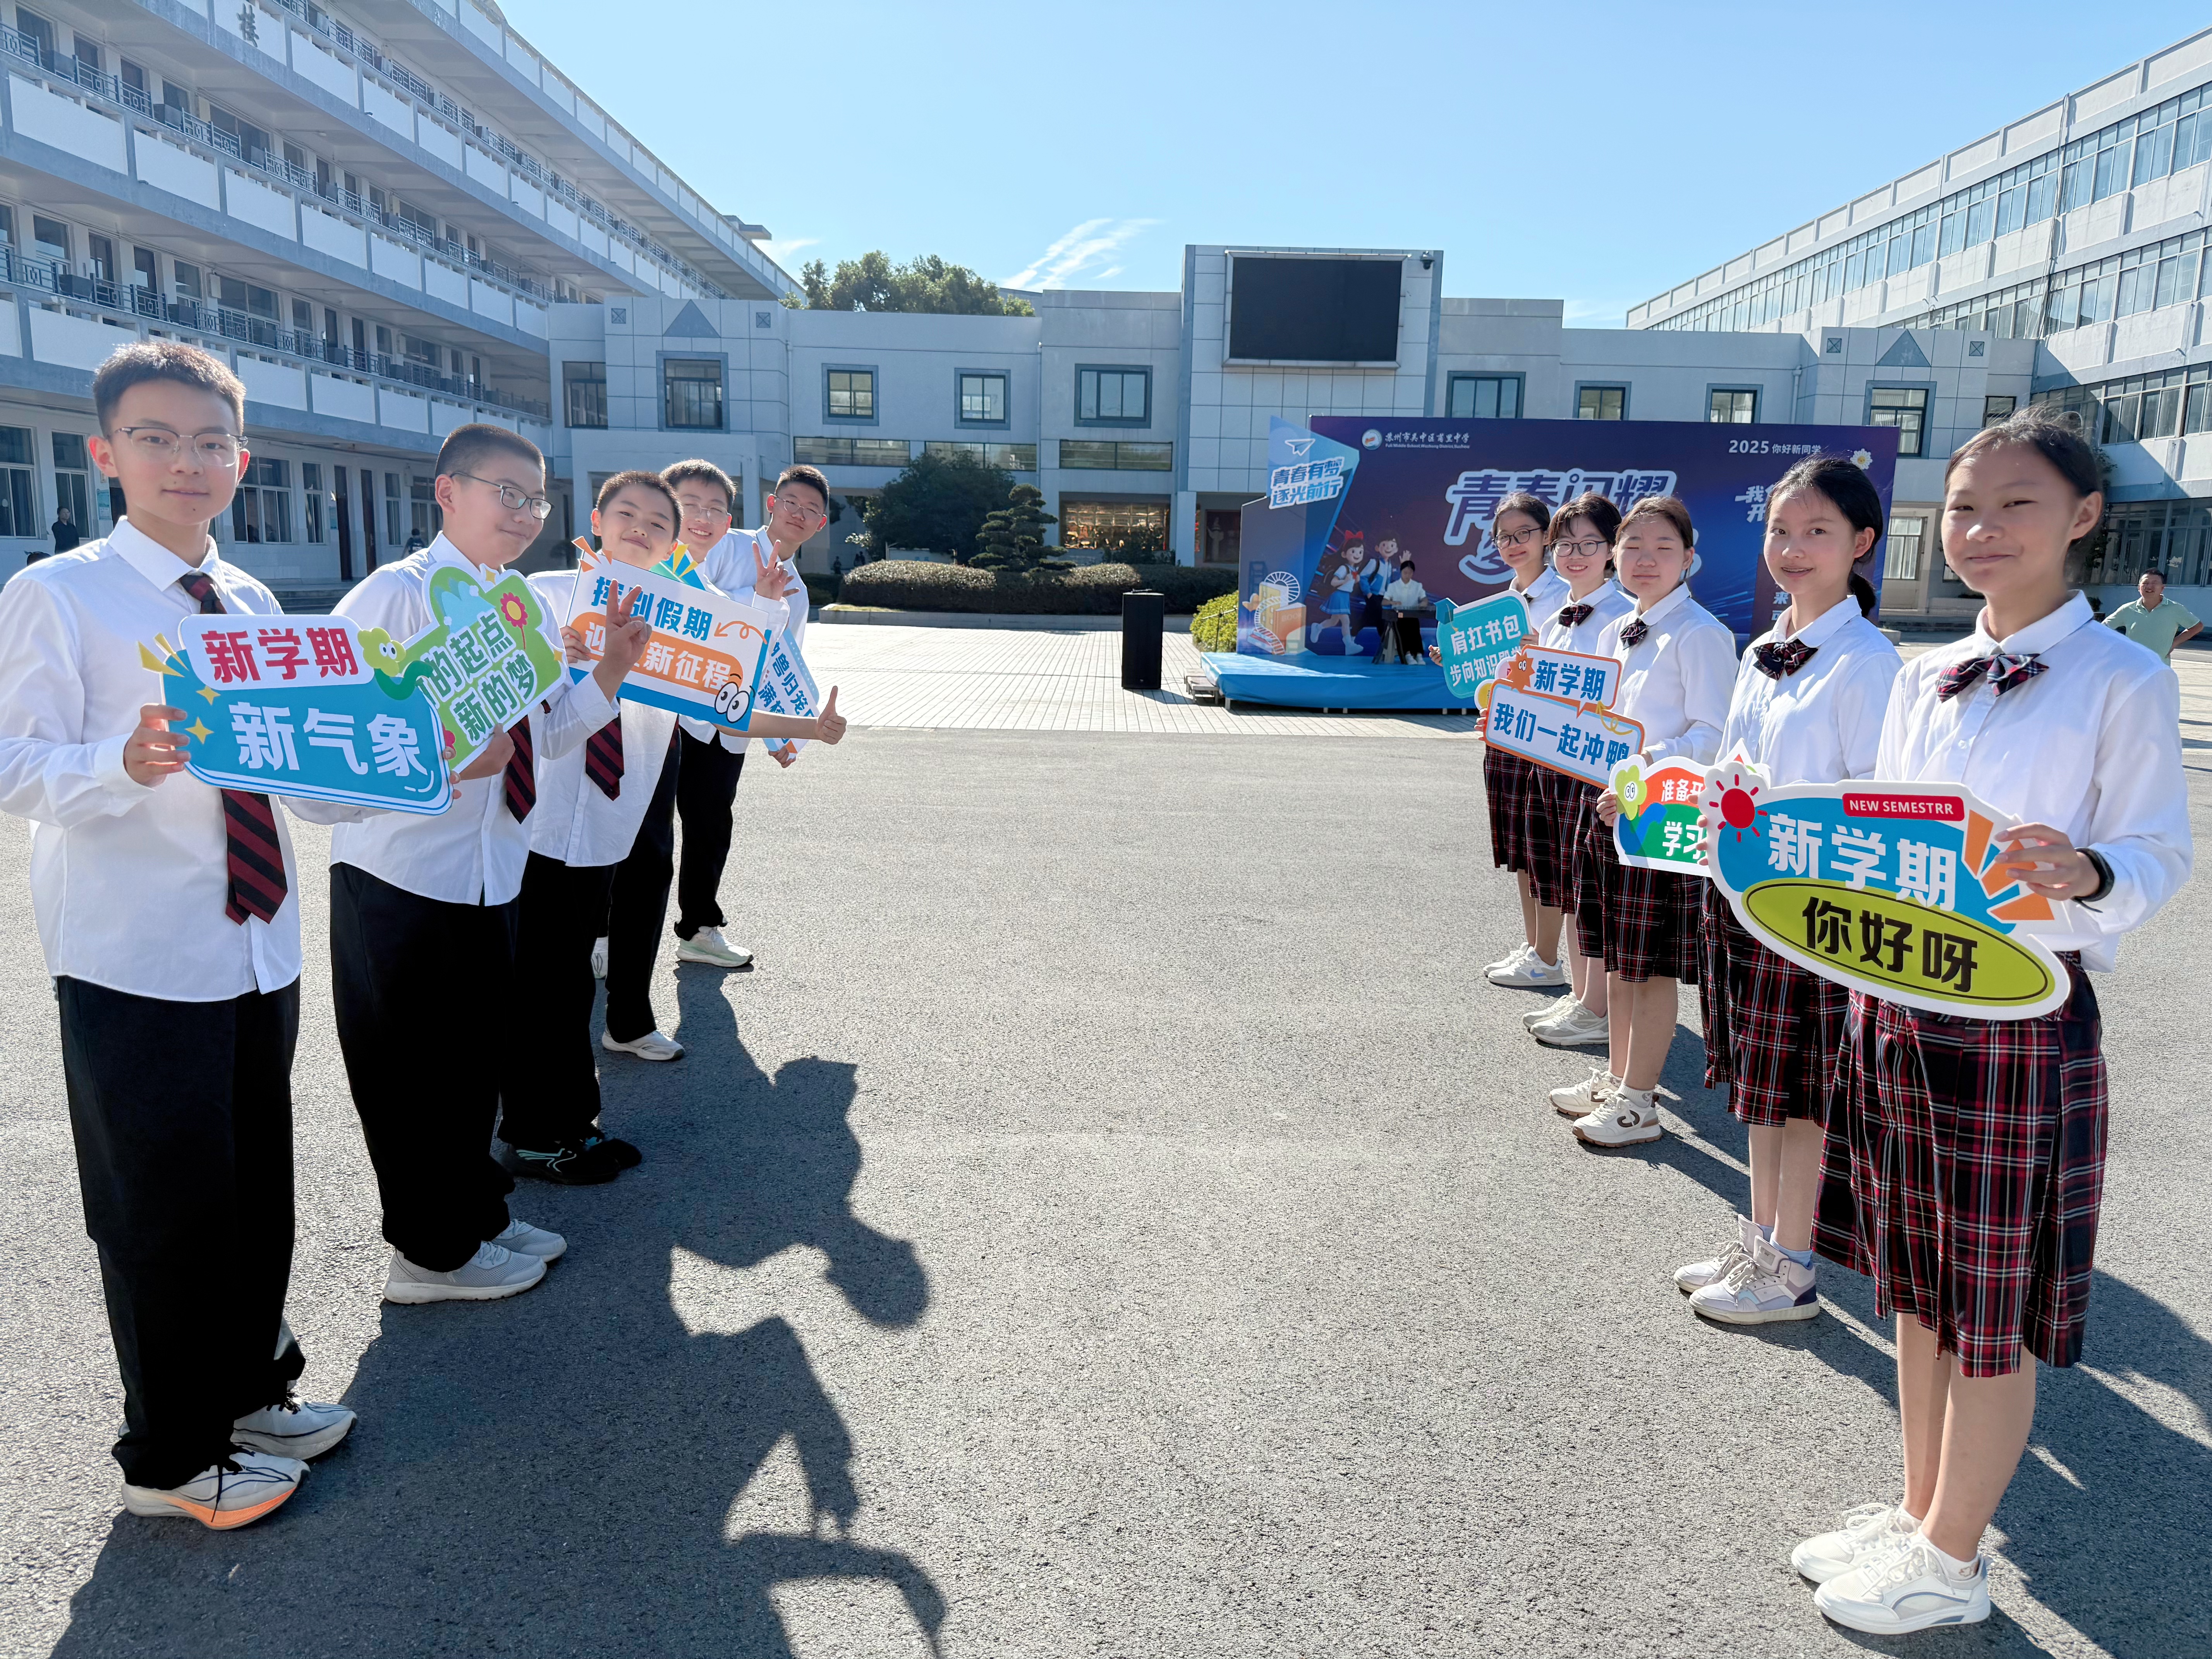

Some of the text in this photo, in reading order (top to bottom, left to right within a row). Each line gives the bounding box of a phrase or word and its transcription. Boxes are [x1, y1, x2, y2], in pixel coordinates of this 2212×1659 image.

[1273, 459, 1343, 487] 青春有梦
[1729, 440, 1821, 454] 2025 你好新同学
[1272, 479, 1341, 507] 逐光前行
[201, 627, 359, 684] 新学期
[416, 613, 513, 706] 的起点
[585, 621, 731, 690] 迎新征程
[1451, 615, 1522, 656] 肩扛书包
[455, 653, 534, 742] 新的梦
[1534, 660, 1606, 701] 新学期
[229, 701, 428, 777] 新气象
[1494, 702, 1630, 771] 我们一起冲鸭
[1850, 800, 1954, 814] NEW SEMESTRR
[1768, 813, 1957, 912] 新学期
[1802, 897, 1978, 993] 你好呀
